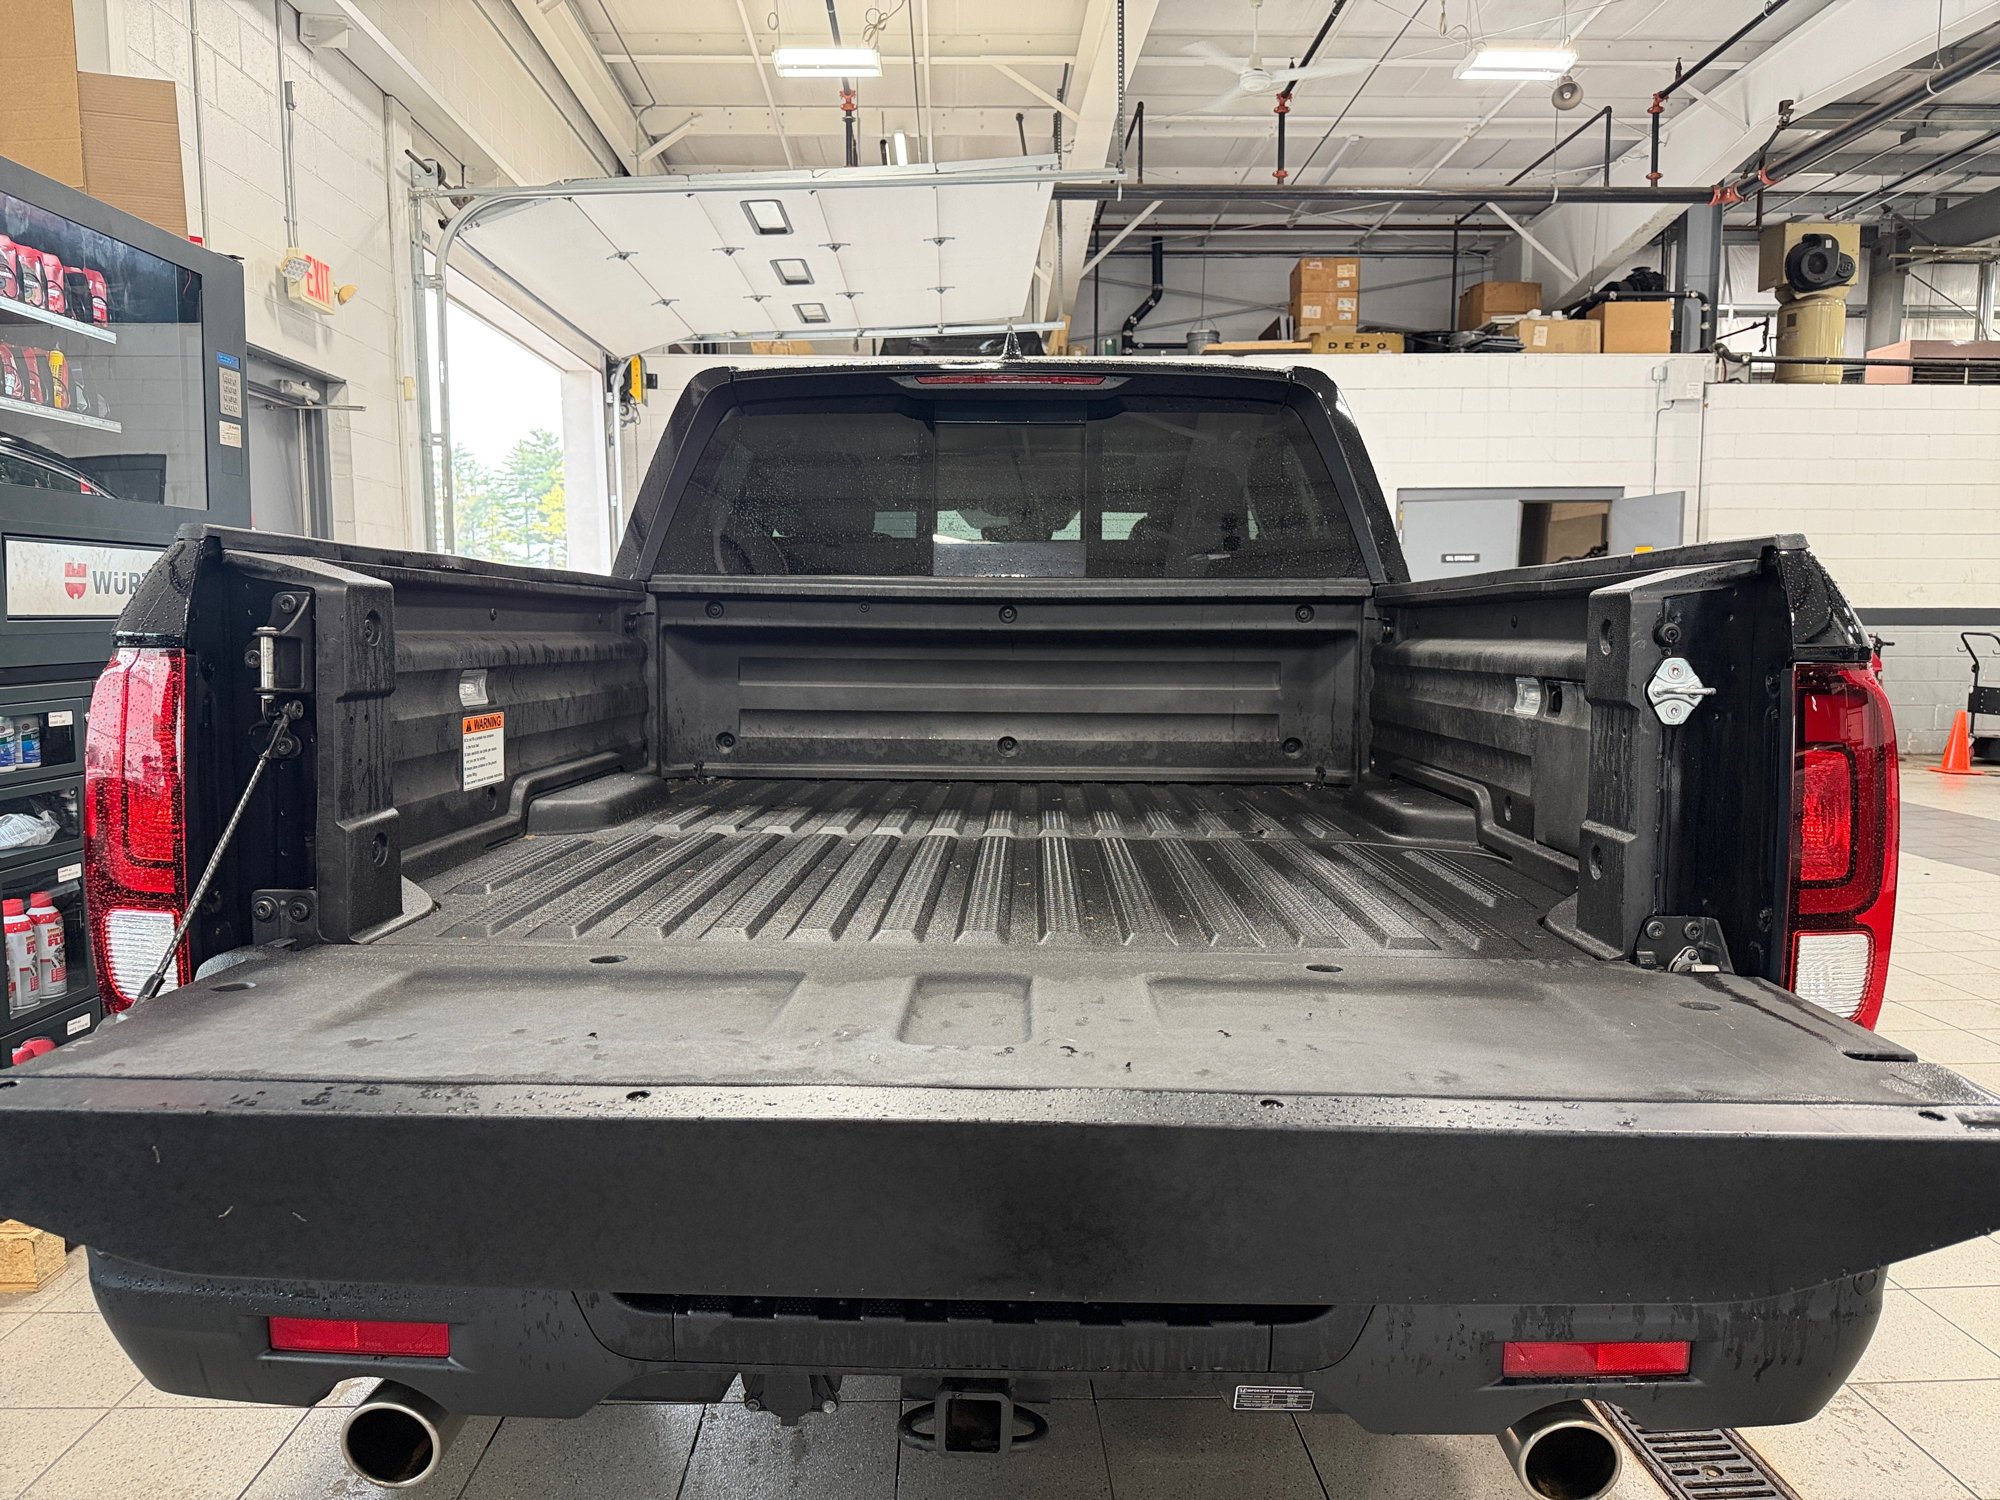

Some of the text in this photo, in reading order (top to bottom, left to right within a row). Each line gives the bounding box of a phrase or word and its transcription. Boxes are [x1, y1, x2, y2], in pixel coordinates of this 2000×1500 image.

[305, 254, 330, 305] EXIT
[1328, 342, 1386, 350] DEPO
[92, 570, 148, 595] WÜR
[474, 715, 502, 731] WARNING
